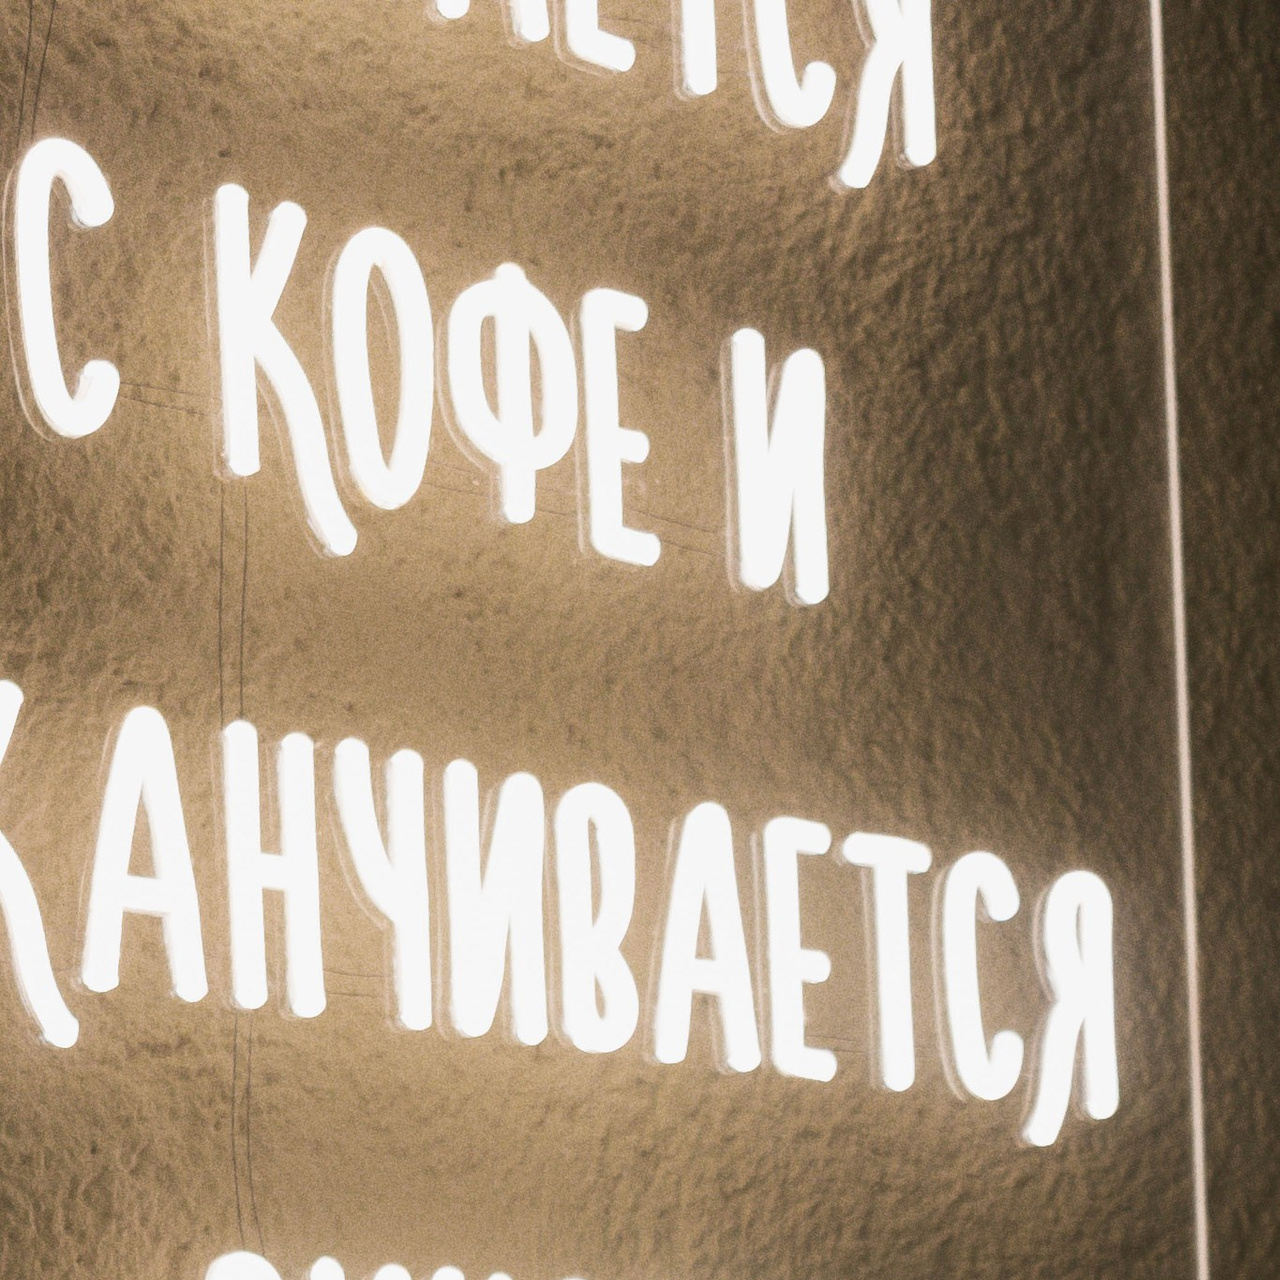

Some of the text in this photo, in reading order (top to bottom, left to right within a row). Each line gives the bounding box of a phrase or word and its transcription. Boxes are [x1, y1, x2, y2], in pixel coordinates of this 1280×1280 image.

[14, 136, 830, 605] С КОФЕ И
